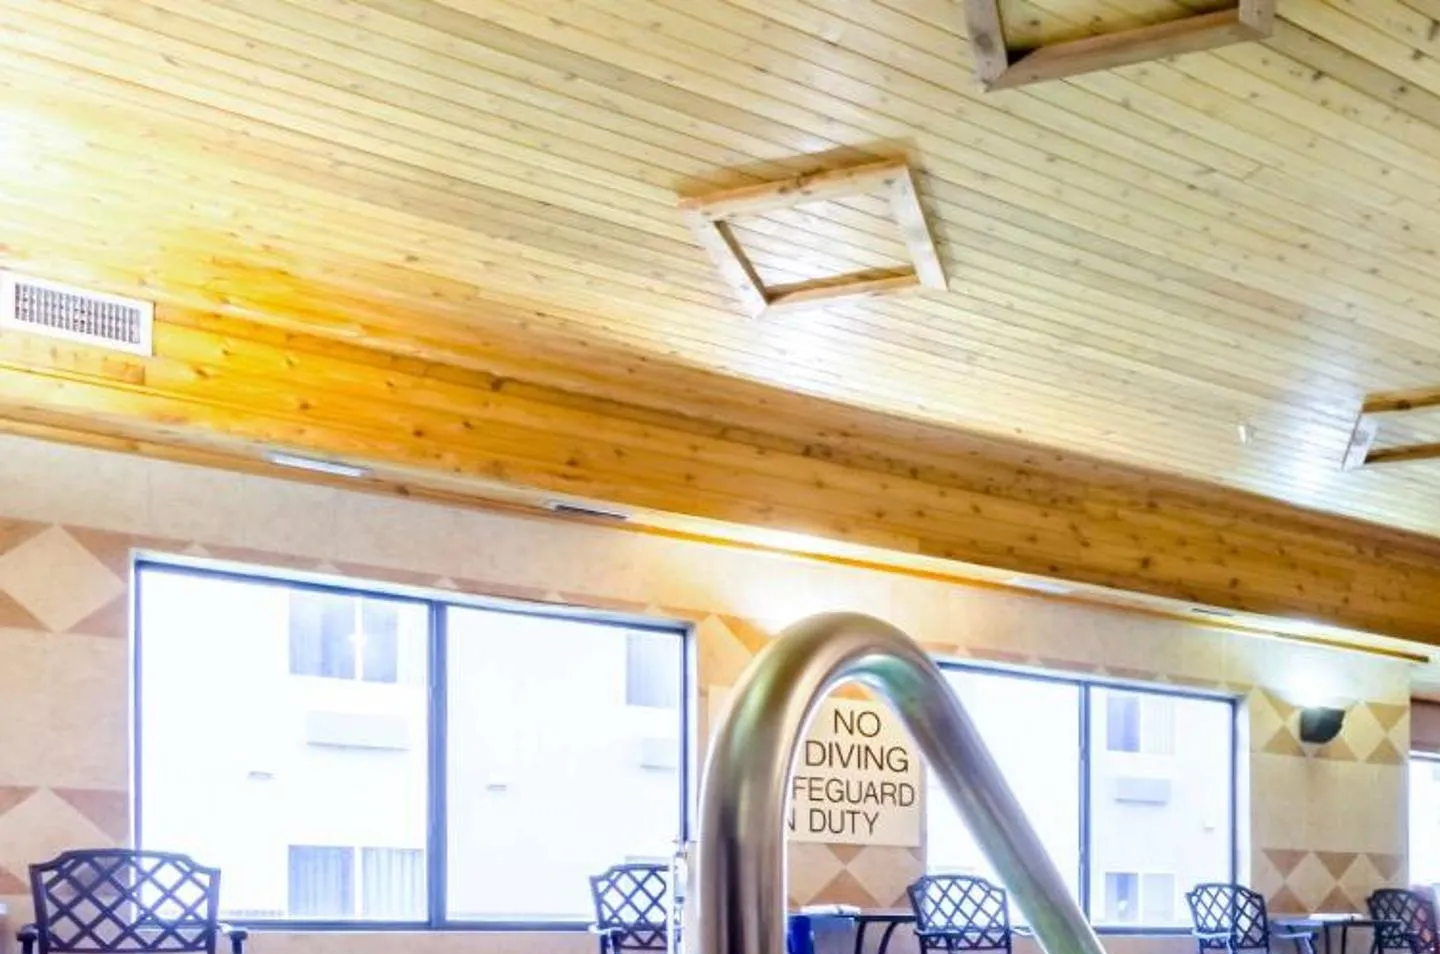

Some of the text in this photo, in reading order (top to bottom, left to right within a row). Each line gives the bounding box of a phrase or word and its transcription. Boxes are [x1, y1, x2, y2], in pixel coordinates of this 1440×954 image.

[833, 709, 882, 738] NO
[804, 740, 909, 773] DIVING
[792, 776, 915, 807] FEGUARD
[809, 808, 880, 836] DUTY
